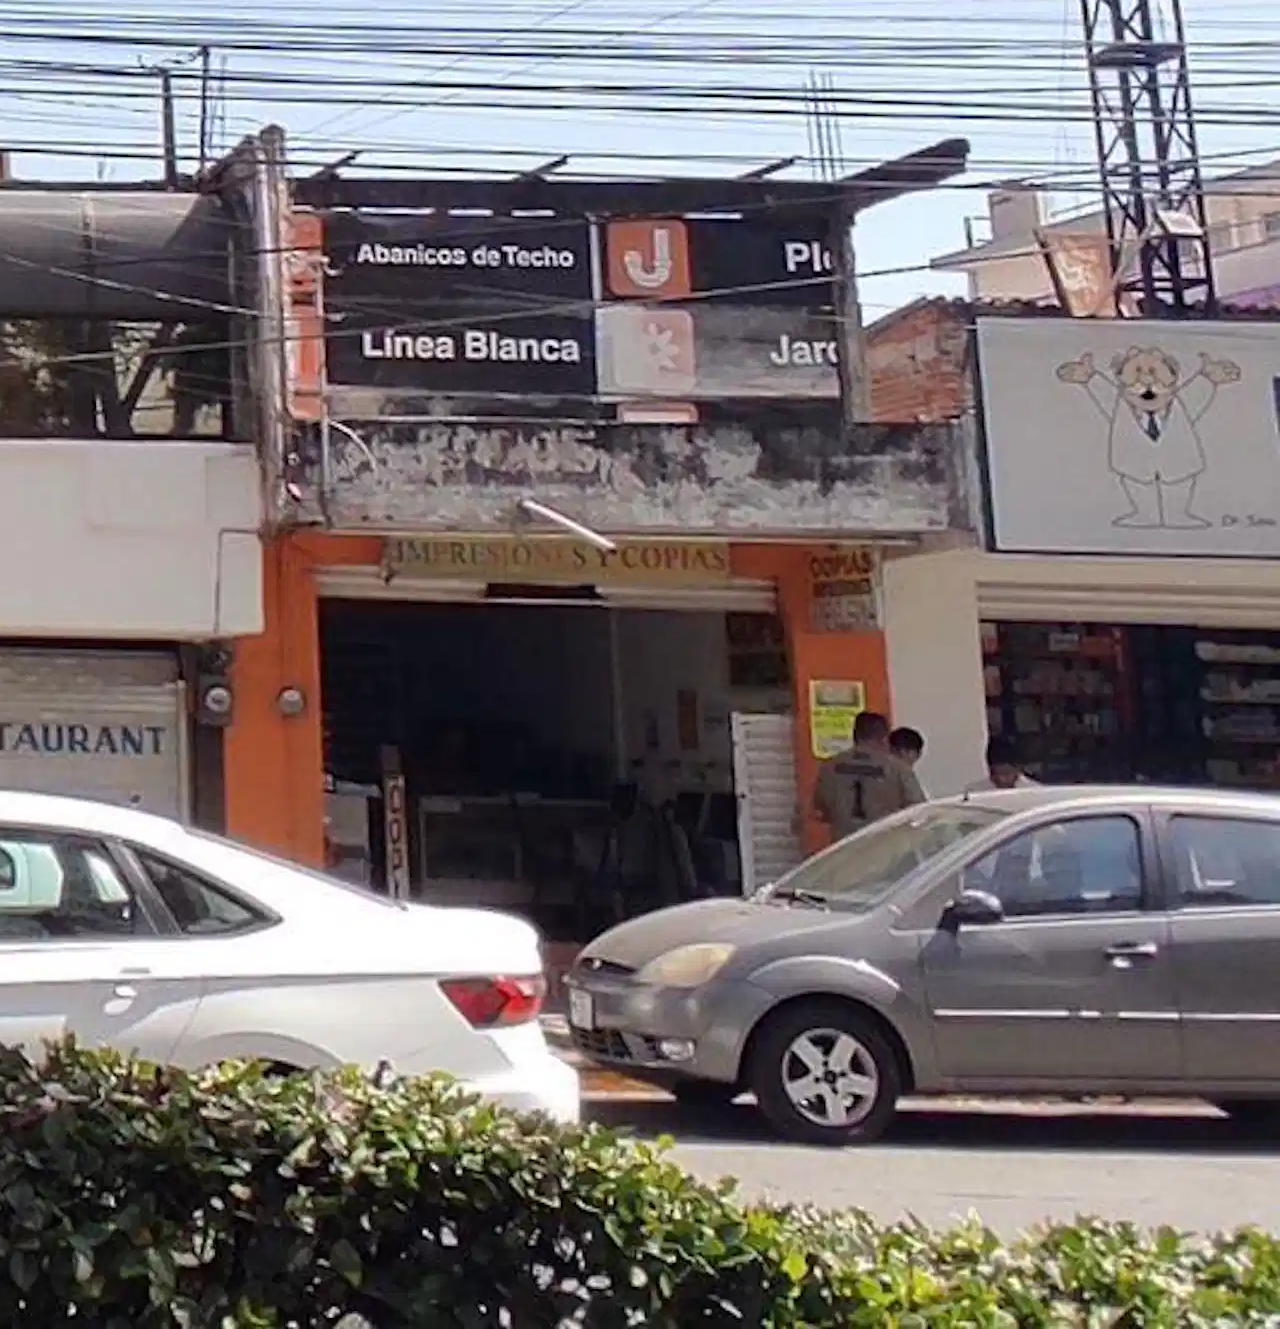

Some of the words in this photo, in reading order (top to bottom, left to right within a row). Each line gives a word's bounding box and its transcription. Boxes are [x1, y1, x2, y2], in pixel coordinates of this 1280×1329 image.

[357, 242, 466, 266] Abanicos
[472, 244, 501, 267] de
[501, 246, 574, 268] Techo
[624, 227, 670, 287] J
[361, 329, 454, 360] Línea
[465, 332, 580, 363] Blanca
[621, 544, 725, 570] COPIAS
